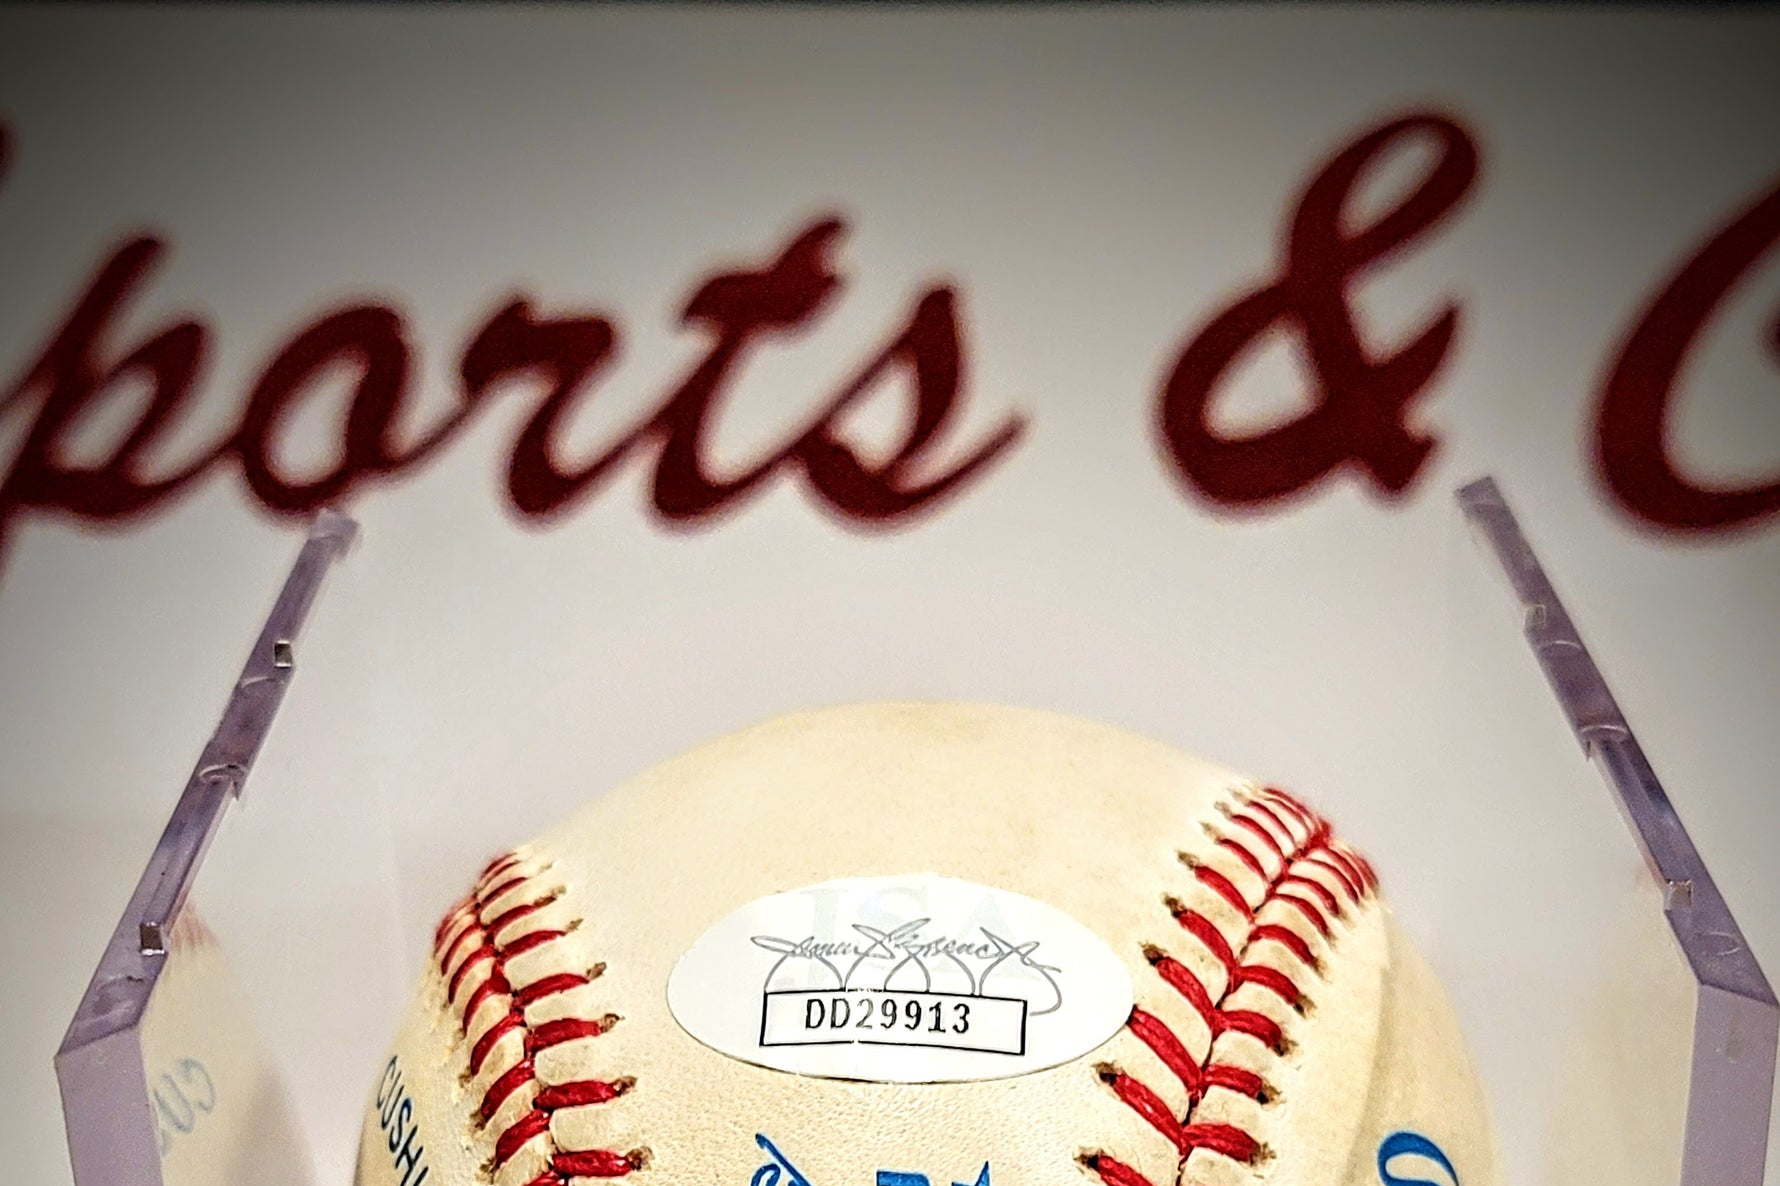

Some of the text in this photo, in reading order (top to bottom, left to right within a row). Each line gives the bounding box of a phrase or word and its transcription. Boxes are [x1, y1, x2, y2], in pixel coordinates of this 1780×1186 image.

[0, 212, 1026, 572] ports
[1155, 106, 1484, 512] &
[805, 998, 971, 1034] DD29913
